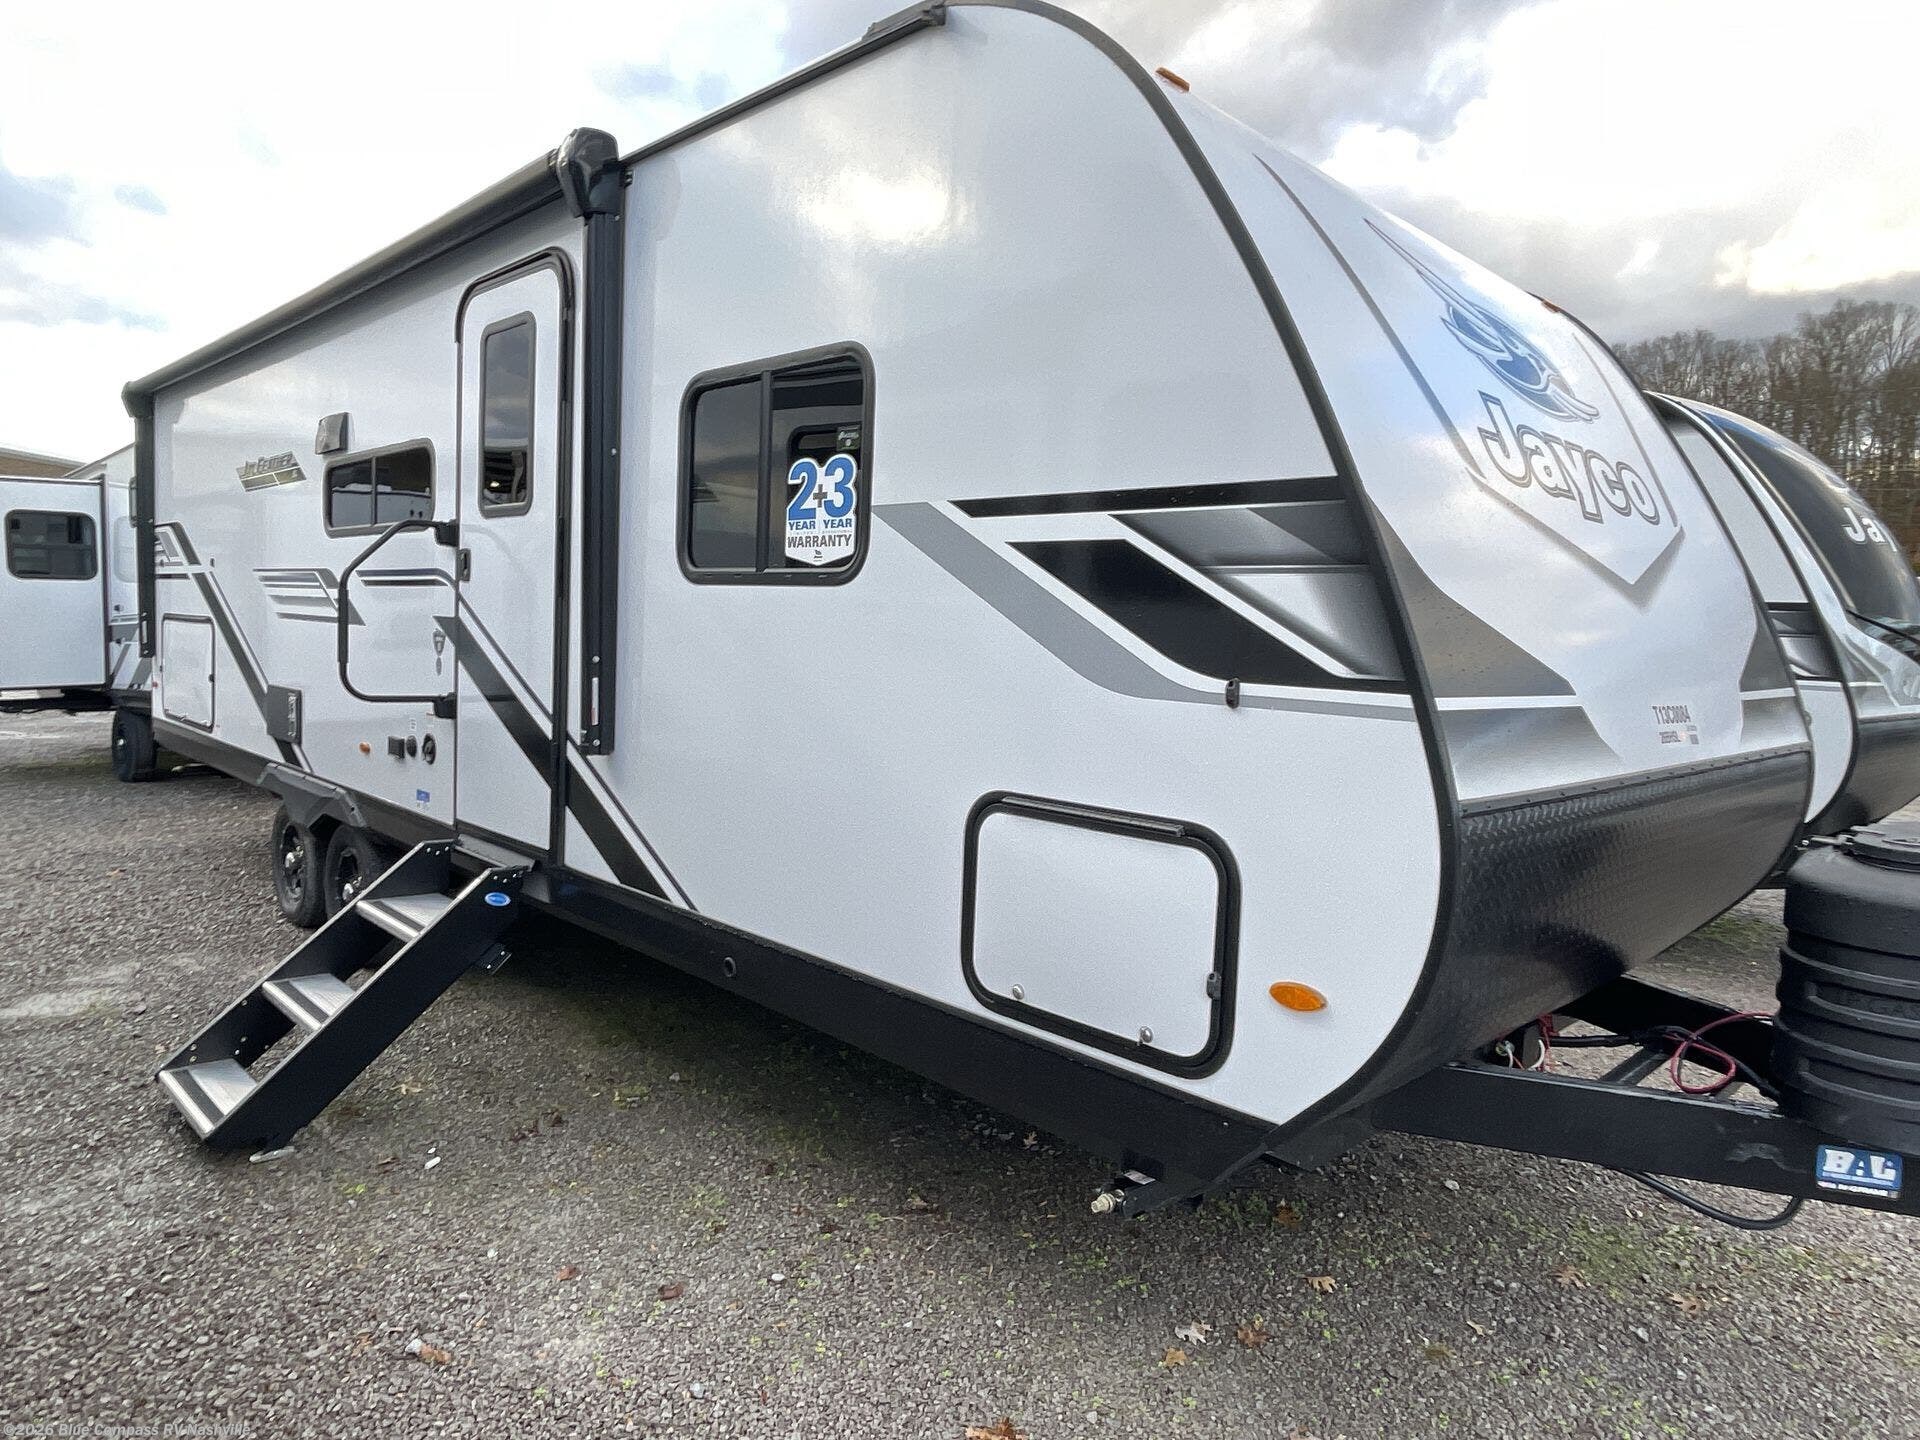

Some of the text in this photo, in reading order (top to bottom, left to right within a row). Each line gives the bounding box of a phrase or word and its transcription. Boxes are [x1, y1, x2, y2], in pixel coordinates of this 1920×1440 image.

[1477, 390, 1660, 526] Jayco
[788, 518, 853, 531] YEAR YEAR
[787, 534, 852, 549] WARRANTY
